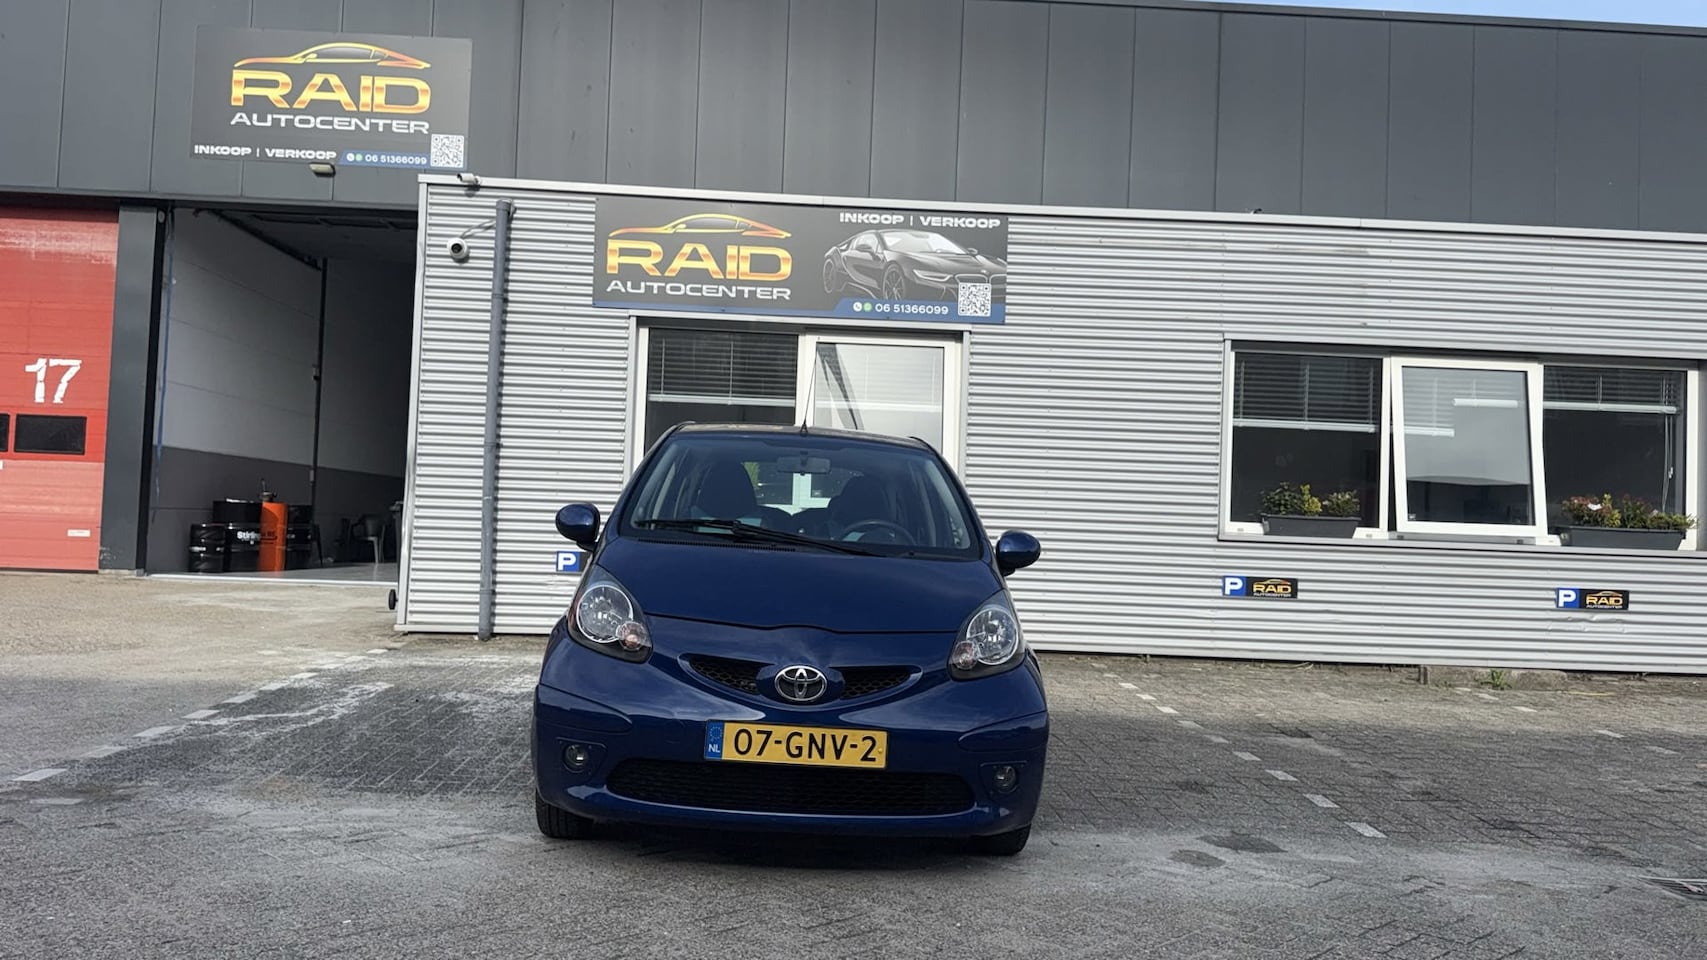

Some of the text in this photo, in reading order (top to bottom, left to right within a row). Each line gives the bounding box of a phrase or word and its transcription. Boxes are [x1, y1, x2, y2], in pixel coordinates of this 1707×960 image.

[231, 69, 431, 114] RAID
[230, 112, 429, 134] AUTOCENTER
[194, 144, 252, 156] INKOOP
[265, 148, 337, 160] VERKOOP
[365, 154, 427, 165] 06 51366099
[839, 212, 905, 225] INKOOP
[920, 216, 1000, 229] VERKOOP
[607, 239, 792, 281] RAID
[606, 280, 791, 300] AUTOCENTER
[875, 303, 949, 315] 06 51366099
[25, 358, 82, 403] 17
[558, 552, 577, 571] P
[1224, 577, 1292, 595] P RAID
[1558, 589, 1623, 607] P RAID
[708, 728, 878, 763] NL 07-GNV-2
